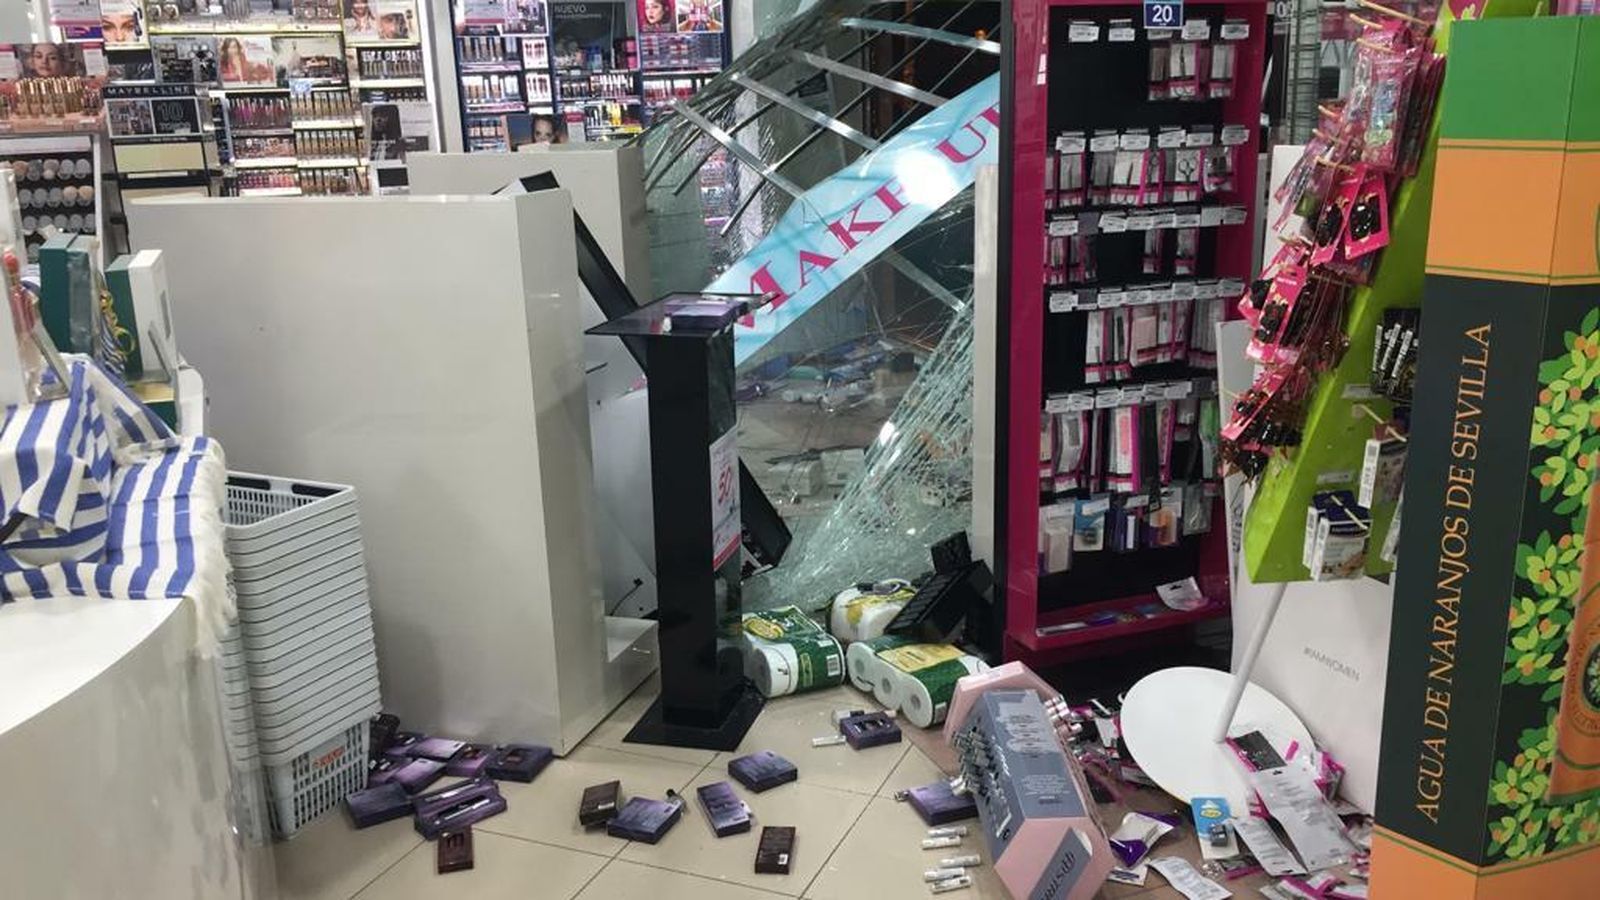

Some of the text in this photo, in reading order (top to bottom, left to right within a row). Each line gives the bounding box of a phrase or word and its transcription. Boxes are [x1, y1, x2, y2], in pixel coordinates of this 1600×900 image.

[554, 4, 587, 14] NUEVO
[1152, 4, 1173, 23] 20
[107, 86, 190, 95] MAYBELLINE
[1415, 322, 1492, 825] AGUA DE NARANJOS DE SEVILLA
